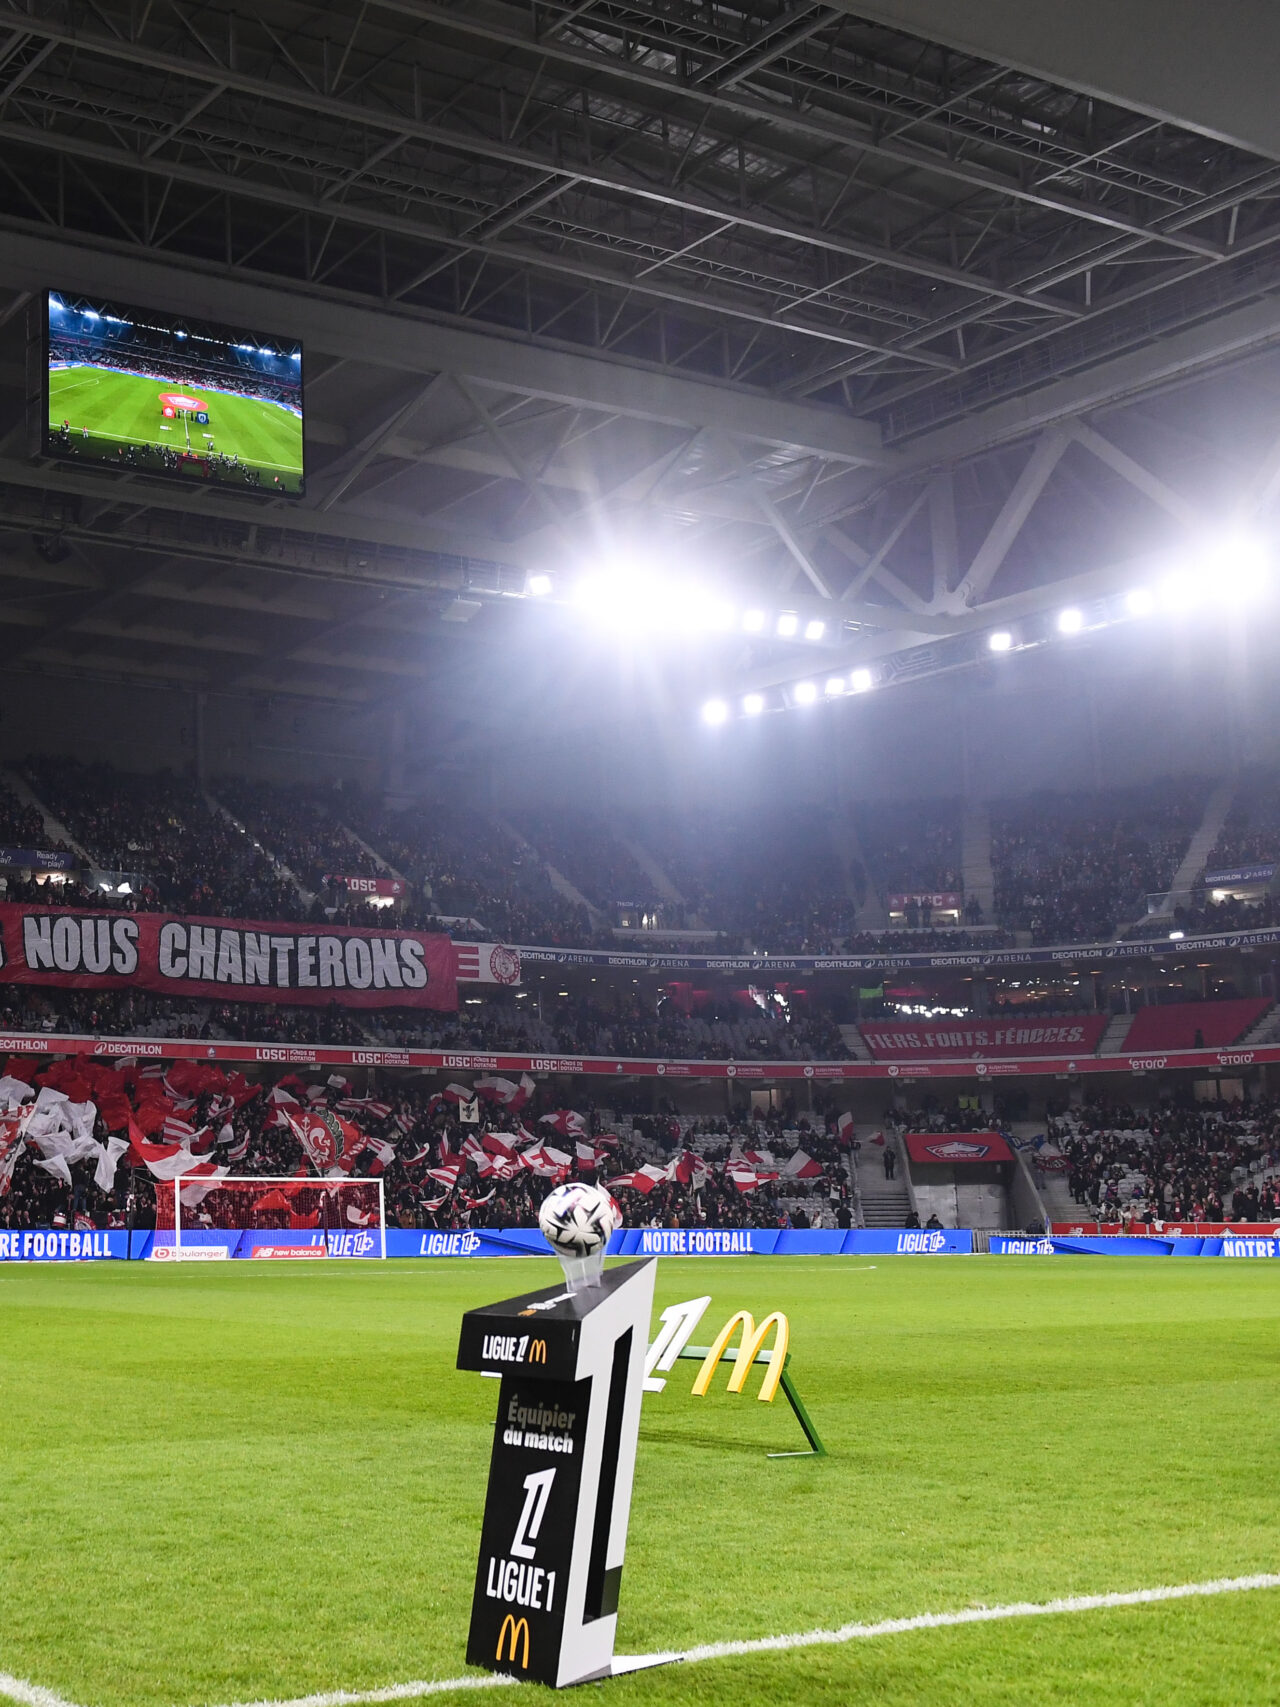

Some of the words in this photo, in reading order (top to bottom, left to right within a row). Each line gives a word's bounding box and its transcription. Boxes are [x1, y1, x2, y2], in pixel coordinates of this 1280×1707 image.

[1175, 939, 1226, 951] DECATHLON
[1242, 934, 1278, 944] ARENA
[23, 915, 139, 974] NOUS
[159, 922, 427, 989] CHANTERONS
[1052, 949, 1102, 960] DECATHLON
[1119, 946, 1155, 956] ARENA
[567, 954, 594, 963] ARENA
[608, 957, 648, 966] DECATHLON
[660, 959, 689, 968] ARENA
[706, 960, 750, 968] DECATHLON
[764, 960, 797, 968] ARENA
[814, 960, 862, 968] DECATHLON
[878, 959, 911, 967] ARENA
[930, 956, 980, 966] DECATHLON
[996, 953, 1032, 963] ARENA
[108, 1043, 162, 1055] DECATHLON
[256, 1049, 286, 1060] LOSC
[352, 1052, 381, 1064] LOSC
[442, 1056, 470, 1068] LOSC
[530, 1060, 558, 1071] LOSC
[24, 1233, 112, 1257] FOOTBALL
[643, 1232, 686, 1252] NOTRE
[688, 1231, 753, 1252] FOOTBALL
[1224, 1240, 1274, 1257] NOTRE
[507, 1394, 576, 1432] Équipier
[504, 1428, 522, 1447] du
[524, 1431, 574, 1454] match
